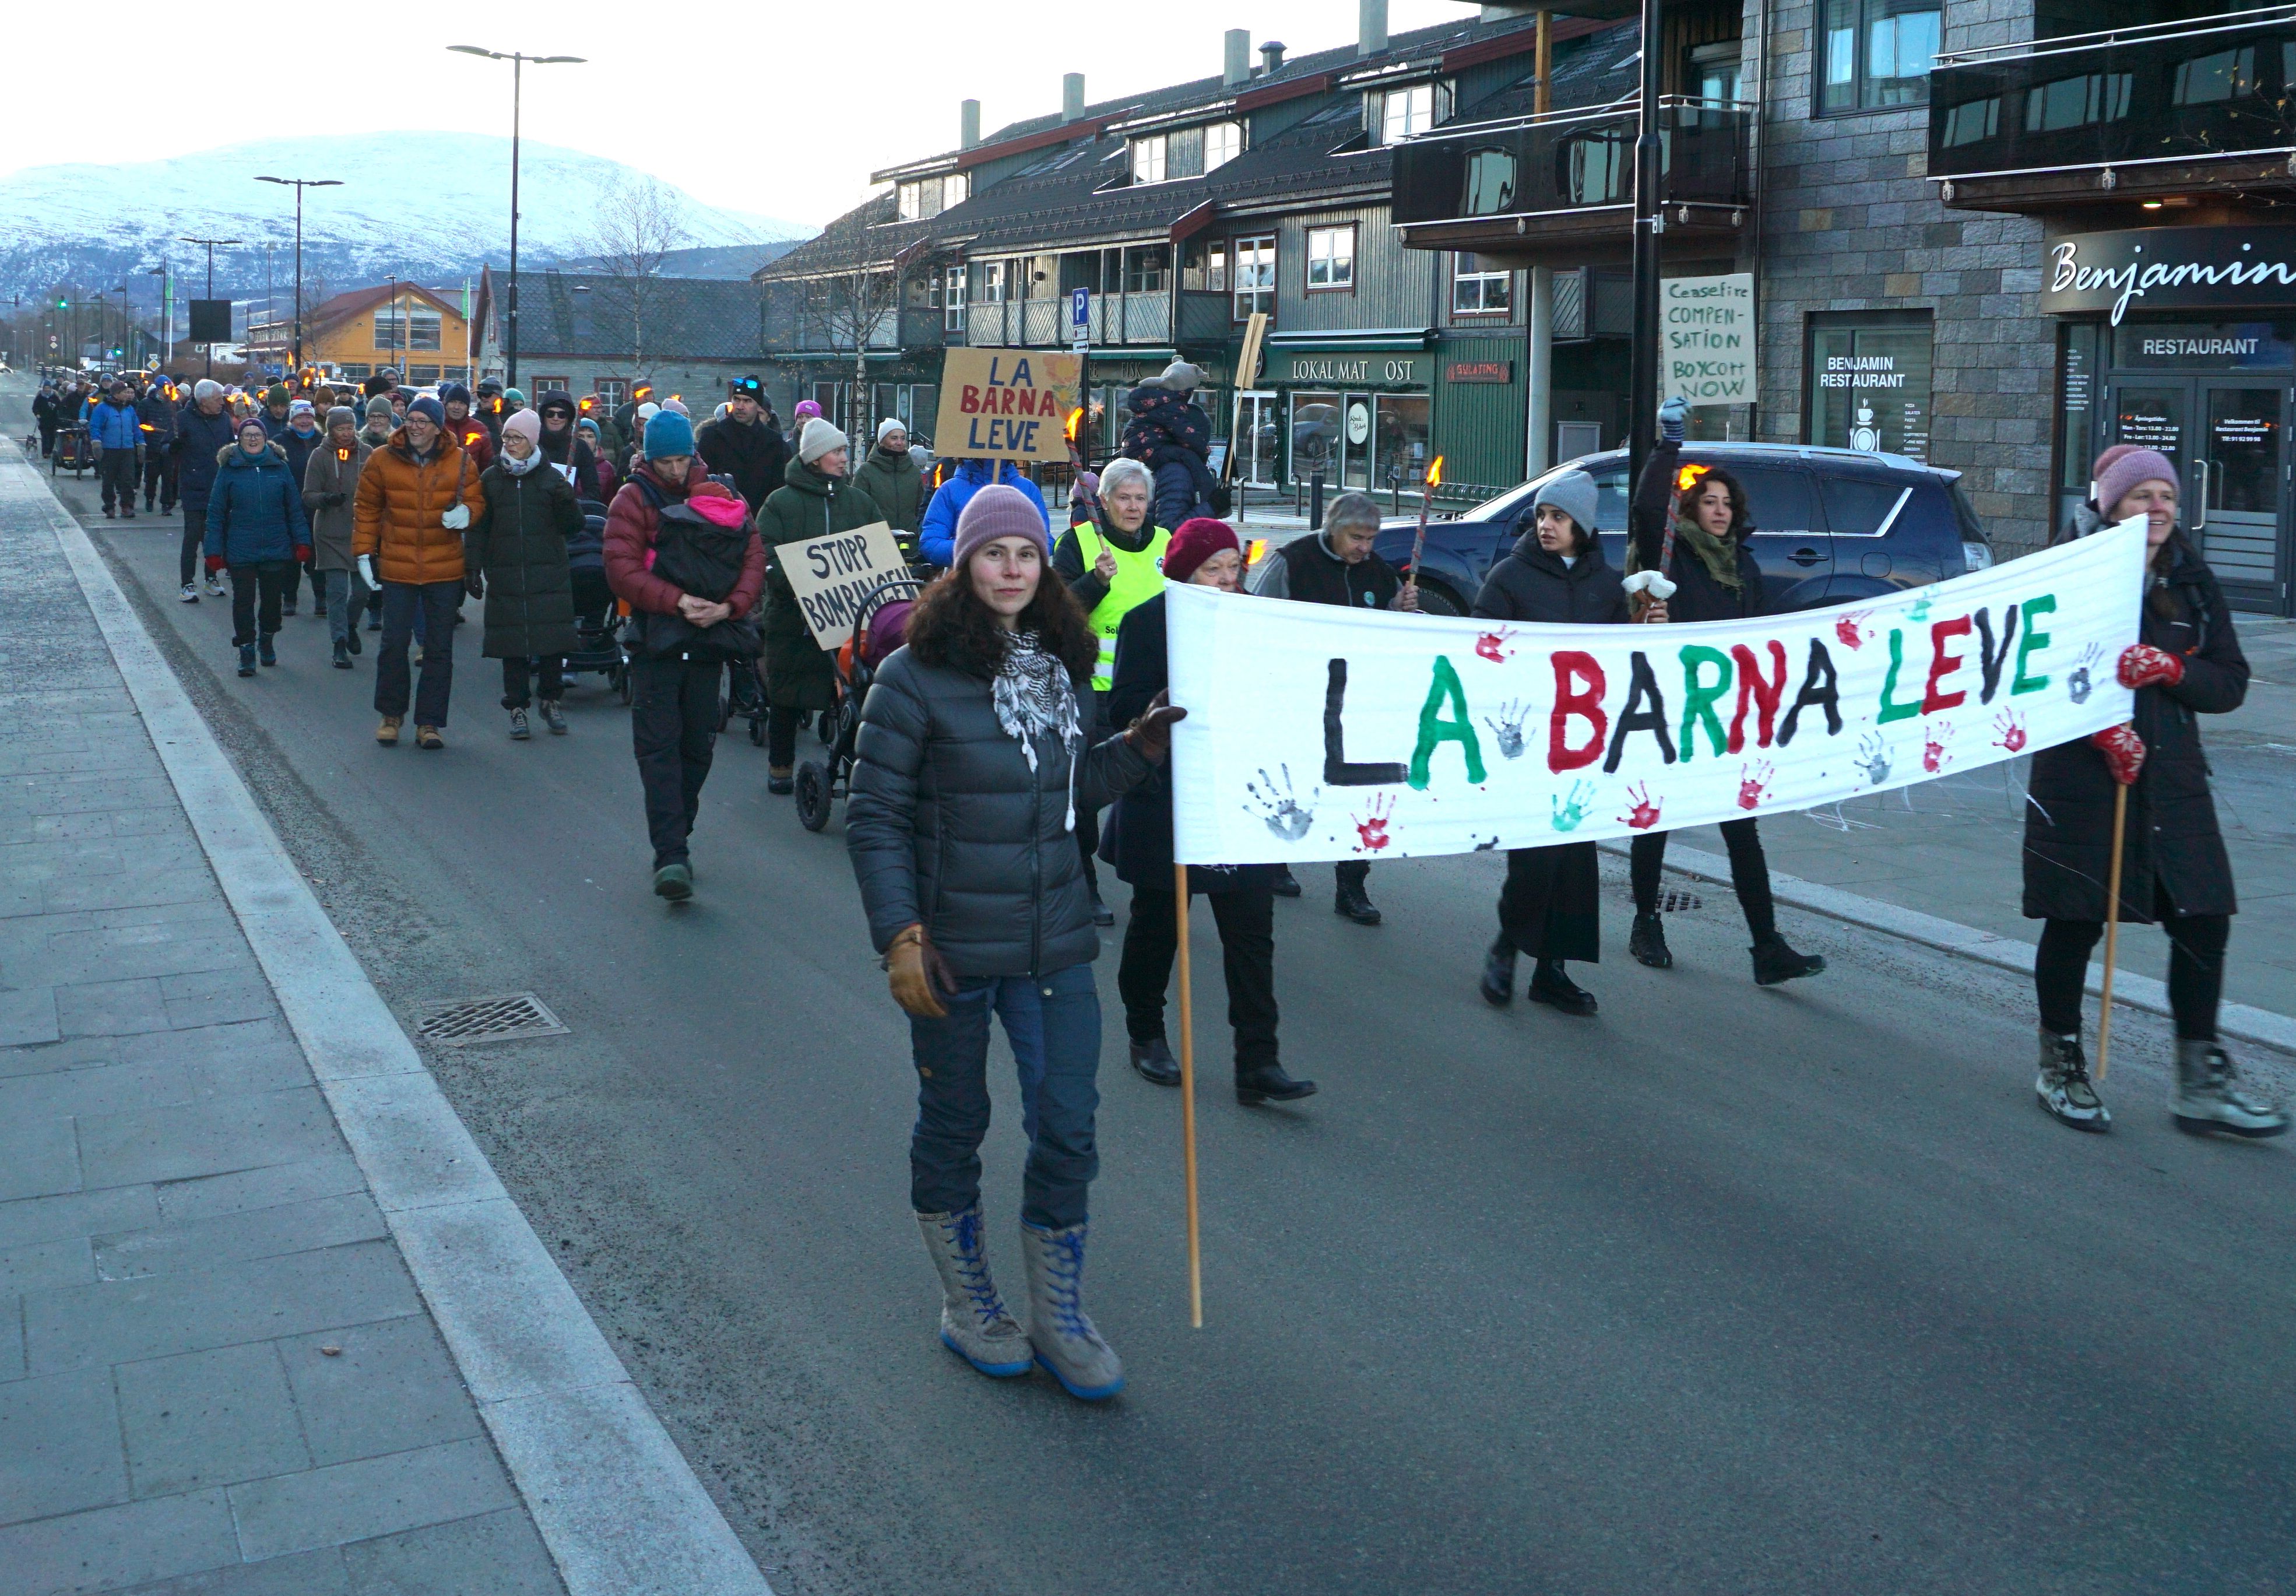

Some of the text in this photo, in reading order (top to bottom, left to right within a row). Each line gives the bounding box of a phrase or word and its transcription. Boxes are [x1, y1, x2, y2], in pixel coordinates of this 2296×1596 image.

[1668, 282, 1748, 298] Ceasefire
[2052, 242, 2296, 326] Benjamin
[1076, 294, 1084, 321] P
[2143, 339, 2258, 354] RESTAURANT
[989, 356, 1032, 387] LA
[1121, 362, 1142, 378] FISK
[1293, 361, 1414, 380] LOKAL MAT OST
[1673, 361, 1746, 379] BOYCOTT
[1828, 357, 1893, 370] BENJAMIN
[1681, 378, 1746, 397] NOW
[1820, 374, 1905, 387] RESTAURANT
[960, 385, 1056, 417] BARNA
[968, 418, 1040, 452] LEVE
[807, 535, 873, 579] STOPP
[801, 566, 918, 632] BOMBINGEN
[1323, 593, 2056, 790] LA BARNA LEVE
